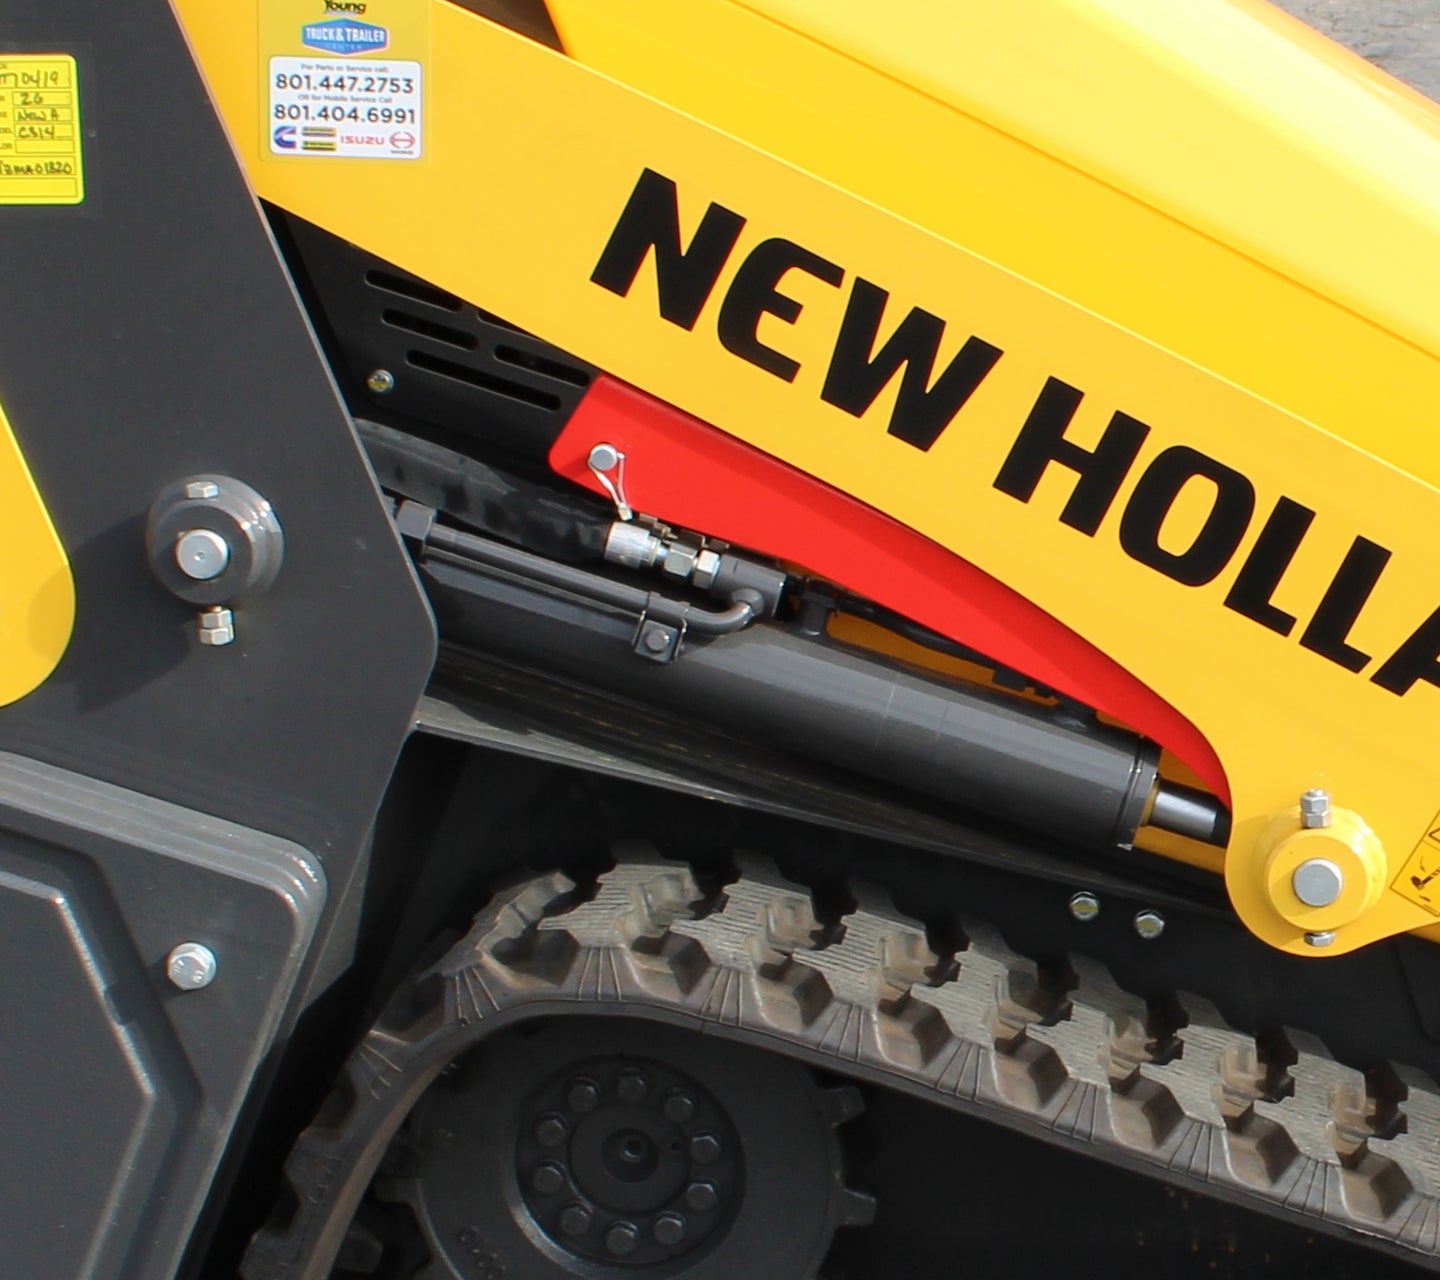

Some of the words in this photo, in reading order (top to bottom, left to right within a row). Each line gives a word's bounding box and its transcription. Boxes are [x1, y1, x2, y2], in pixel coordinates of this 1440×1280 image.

[275, 73, 414, 94] 801.447.2753
[20, 92, 43, 105] 26
[274, 104, 415, 124] 801.404.6991
[340, 135, 385, 145] ISUZU
[590, 167, 1004, 453] NEW
